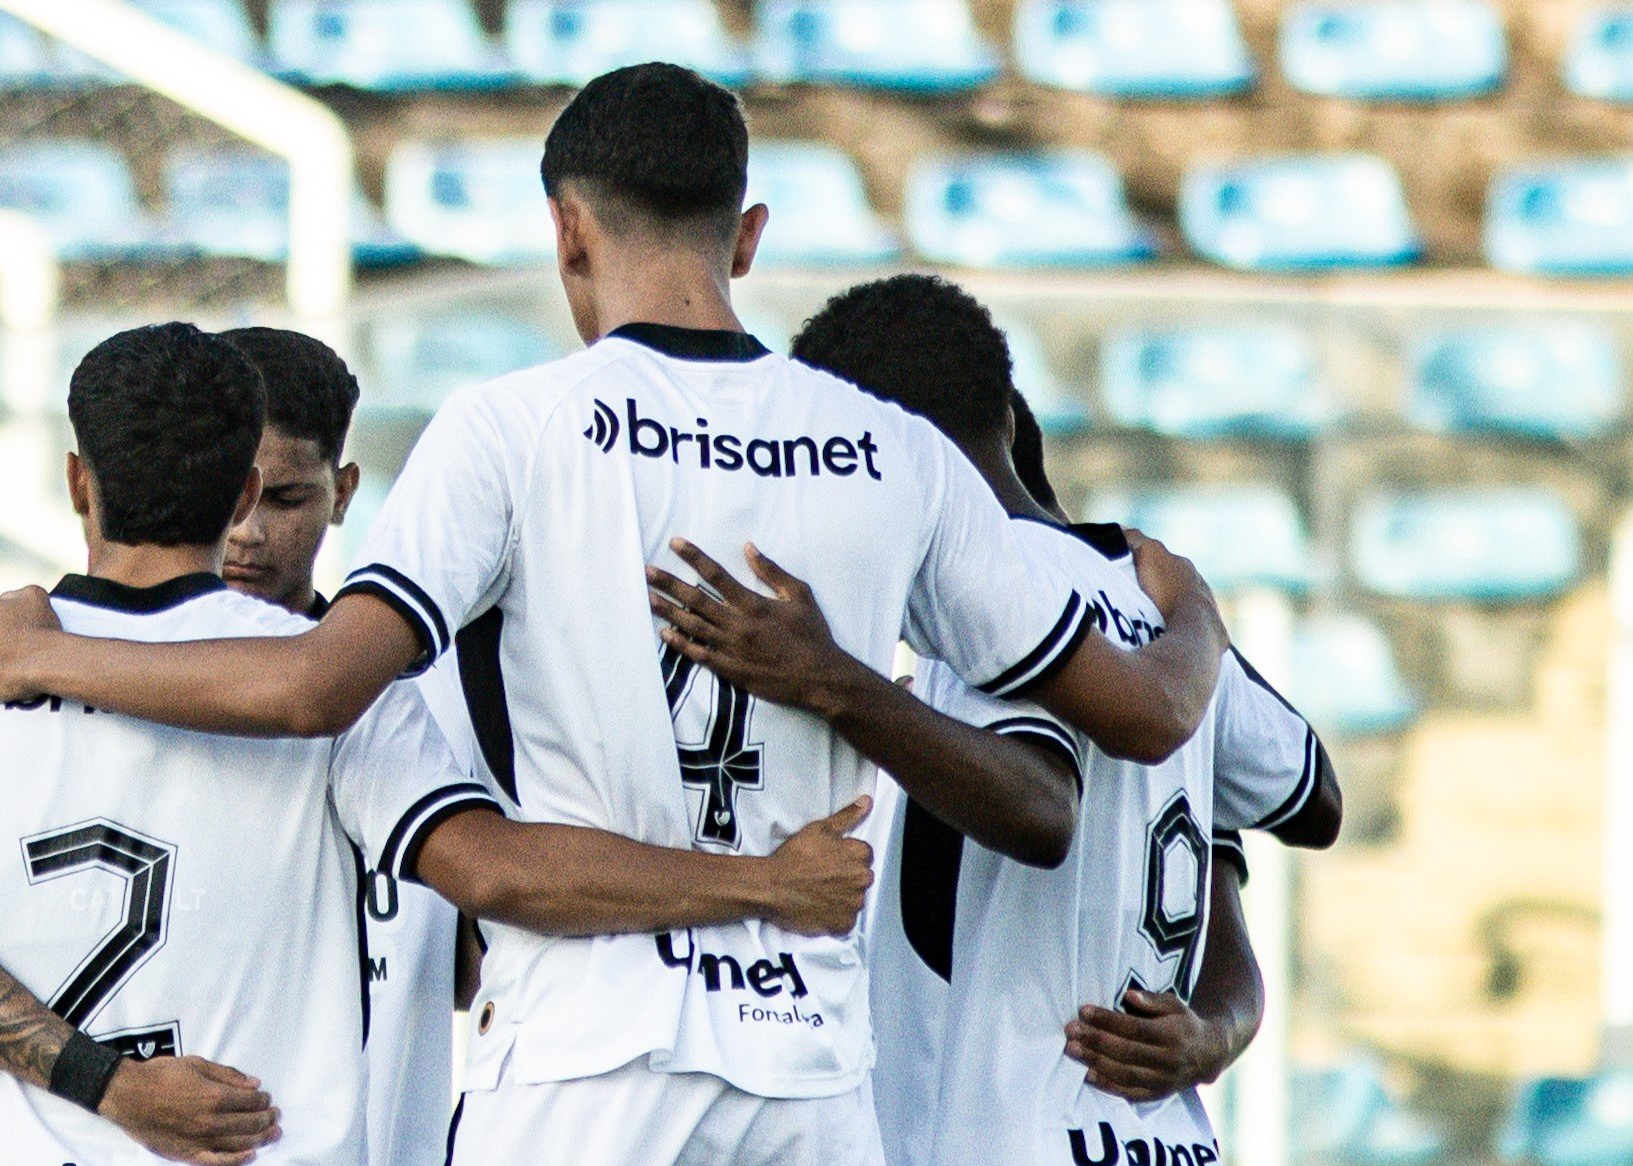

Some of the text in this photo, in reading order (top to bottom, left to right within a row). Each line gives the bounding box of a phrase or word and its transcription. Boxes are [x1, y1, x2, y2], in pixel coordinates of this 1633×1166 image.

[627, 398, 882, 481] brisanet
[20, 816, 183, 1058] 2
[1114, 787, 1212, 1014] 9
